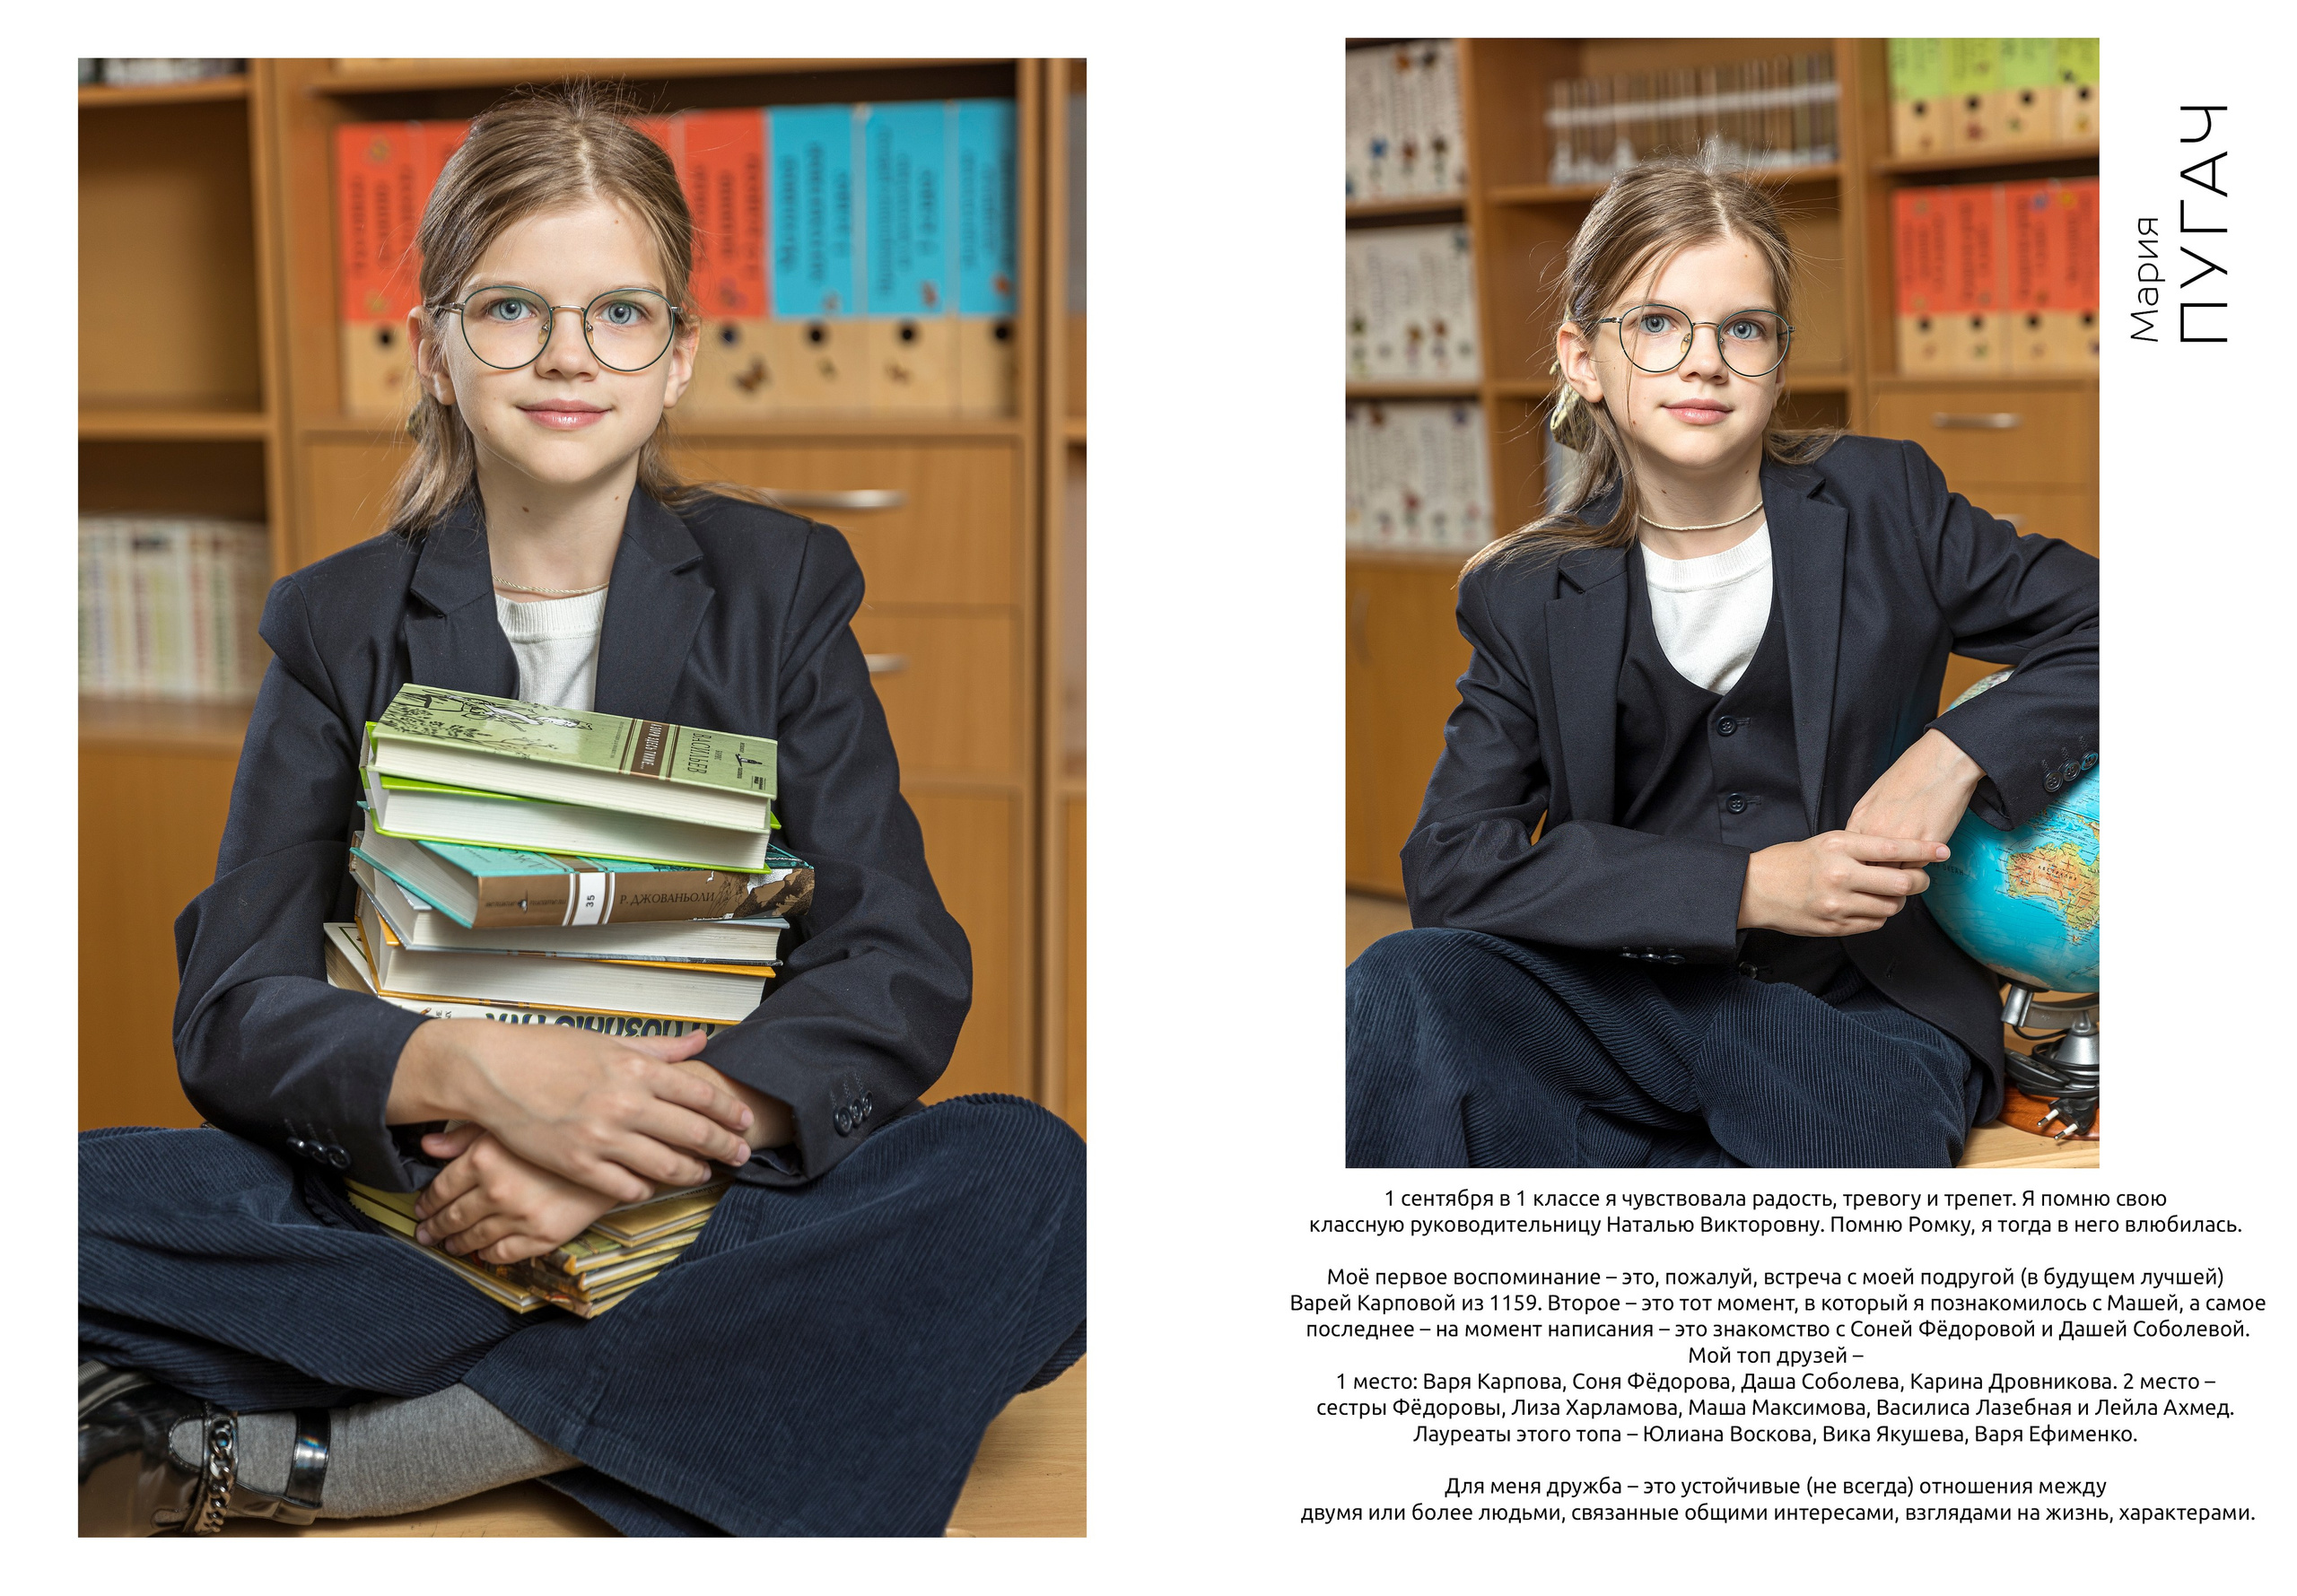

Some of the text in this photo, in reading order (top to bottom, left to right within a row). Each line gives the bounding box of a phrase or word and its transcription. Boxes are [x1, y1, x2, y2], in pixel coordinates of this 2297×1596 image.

[687, 732, 712, 773] ВАСИЛЬЕВ
[585, 894, 596, 907] 35
[619, 892, 715, 906] Р. ДЖОВАНЬОЛИ
